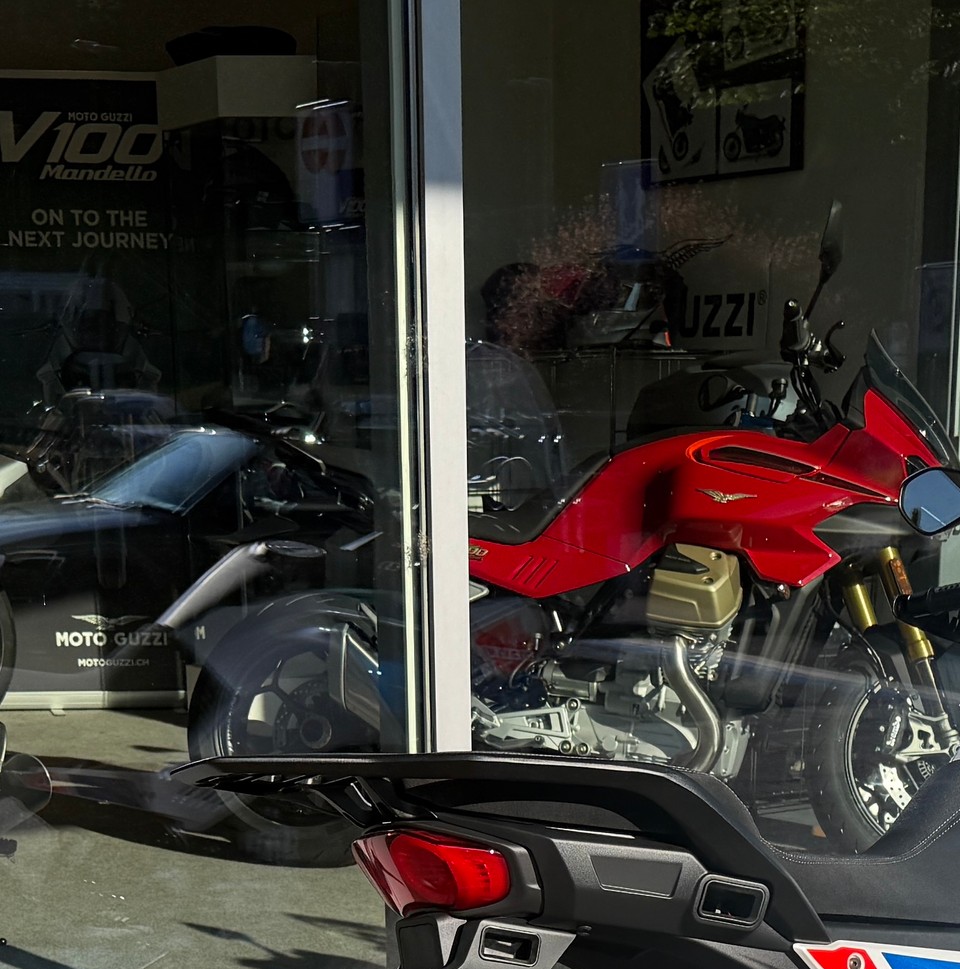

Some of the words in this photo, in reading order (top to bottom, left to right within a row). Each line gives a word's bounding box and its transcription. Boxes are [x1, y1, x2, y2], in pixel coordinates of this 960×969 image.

[68, 111, 98, 121] MOTO
[101, 113, 133, 122] GUZZI
[0, 110, 163, 165] V100
[39, 164, 158, 182] Mandello
[31, 208, 64, 225] ON
[70, 209, 100, 226] TO
[106, 210, 148, 227] THE
[8, 230, 65, 248] NEXT
[72, 231, 173, 249] JOURNEY
[56, 631, 107, 647] MOTO
[114, 632, 168, 646] GUZZI
[78, 658, 150, 667] MOTOGUZZI.CH
